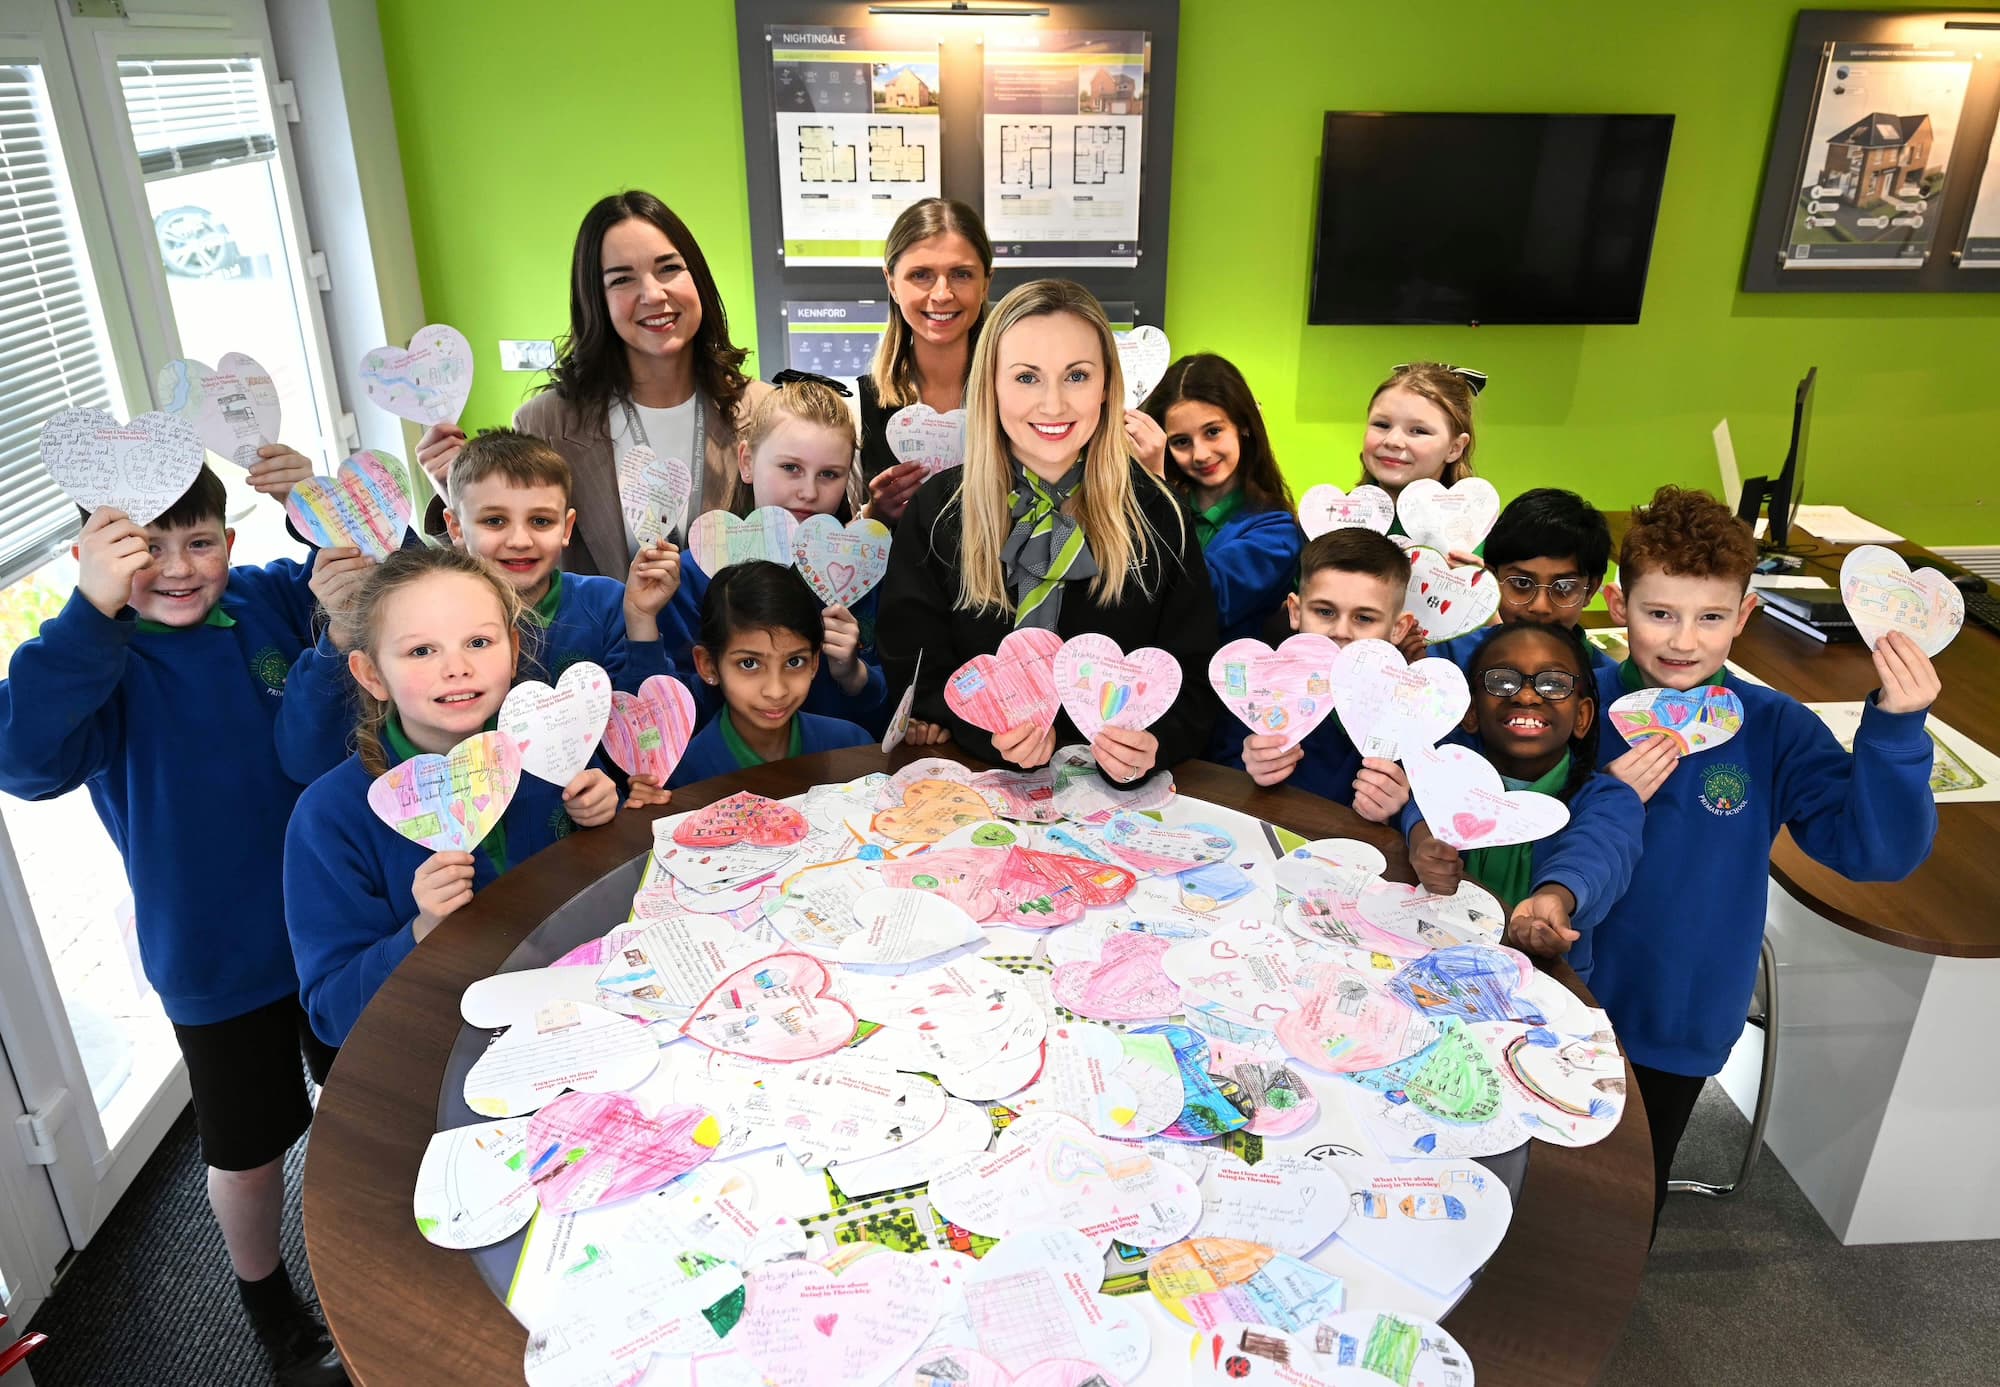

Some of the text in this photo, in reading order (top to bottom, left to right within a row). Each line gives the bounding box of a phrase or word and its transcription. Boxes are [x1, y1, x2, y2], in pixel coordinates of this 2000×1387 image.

[783, 33, 846, 45] NIGHTINGALE
[797, 307, 847, 318] KENNFORD
[266, 687, 284, 697] PRIM
[1699, 762, 1752, 783] THROCKLEY
[1697, 794, 1748, 816] PRIMARY SCHOOL
[980, 1162, 995, 1172] What
[996, 1154, 1009, 1163] love
[1009, 1144, 1024, 1155] about
[981, 1166, 998, 1179] living
[1217, 1173, 1238, 1181] living
[800, 1291, 822, 1299] living
